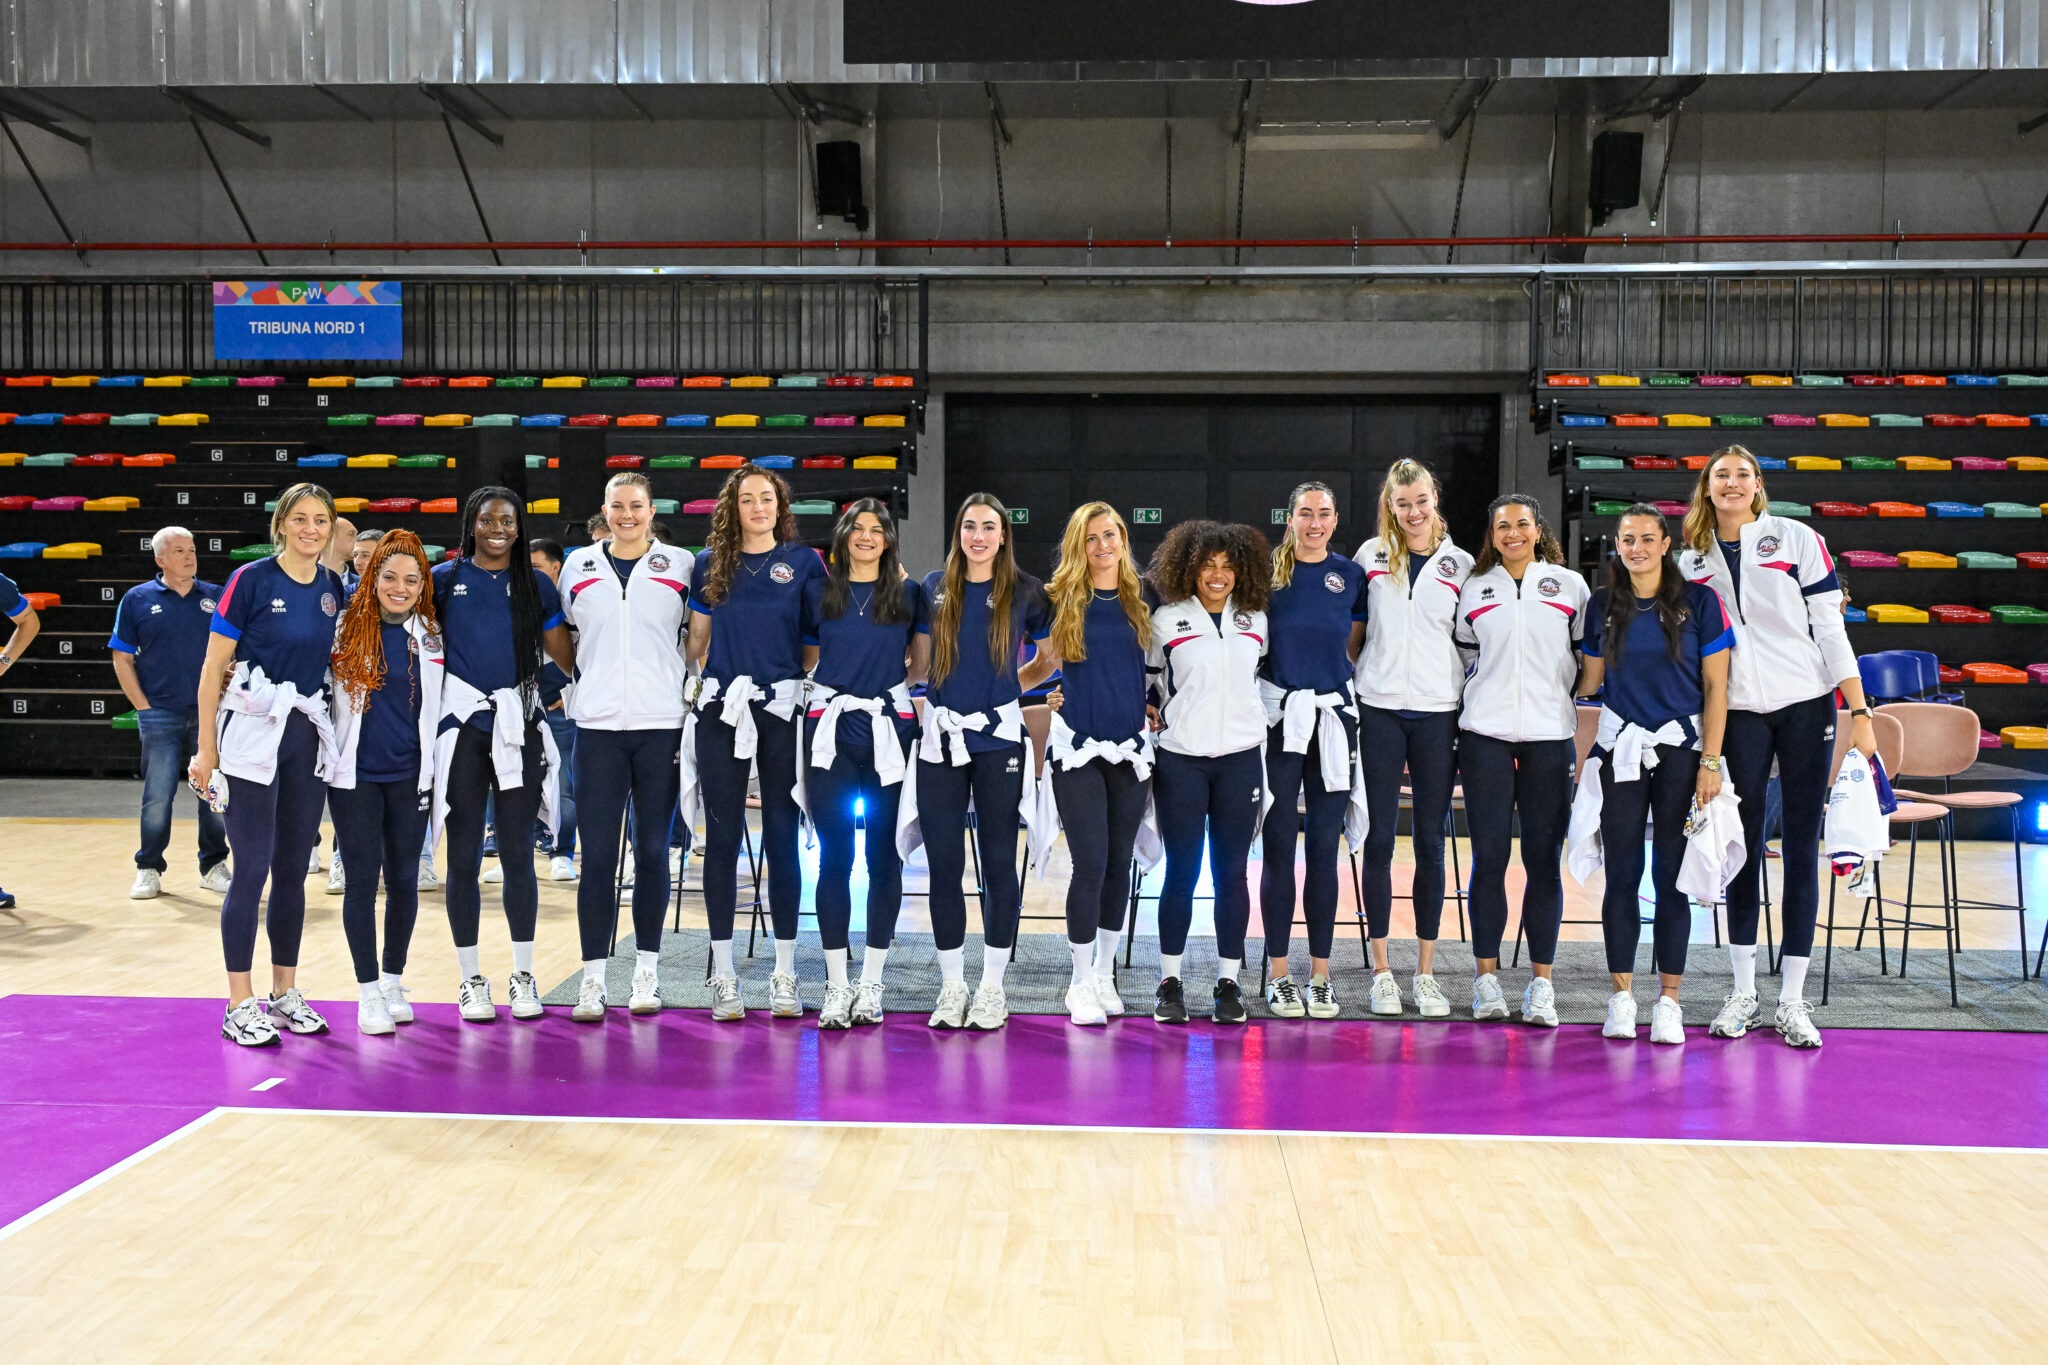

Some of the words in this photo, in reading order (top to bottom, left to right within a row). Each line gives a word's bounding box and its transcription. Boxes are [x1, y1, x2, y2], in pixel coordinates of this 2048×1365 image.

[248, 321, 311, 334] TRIBUNA
[314, 321, 355, 334] NORD
[359, 321, 365, 334] 1
[259, 395, 268, 406] H
[318, 395, 328, 406] H
[212, 450, 222, 461] G
[277, 450, 287, 461] G
[179, 493, 188, 504] F
[246, 493, 255, 504] F
[142, 539, 151, 550] E
[211, 540, 220, 550] E
[104, 589, 113, 599] D
[61, 642, 71, 653] C
[16, 701, 25, 712] B
[93, 702, 103, 713] B
